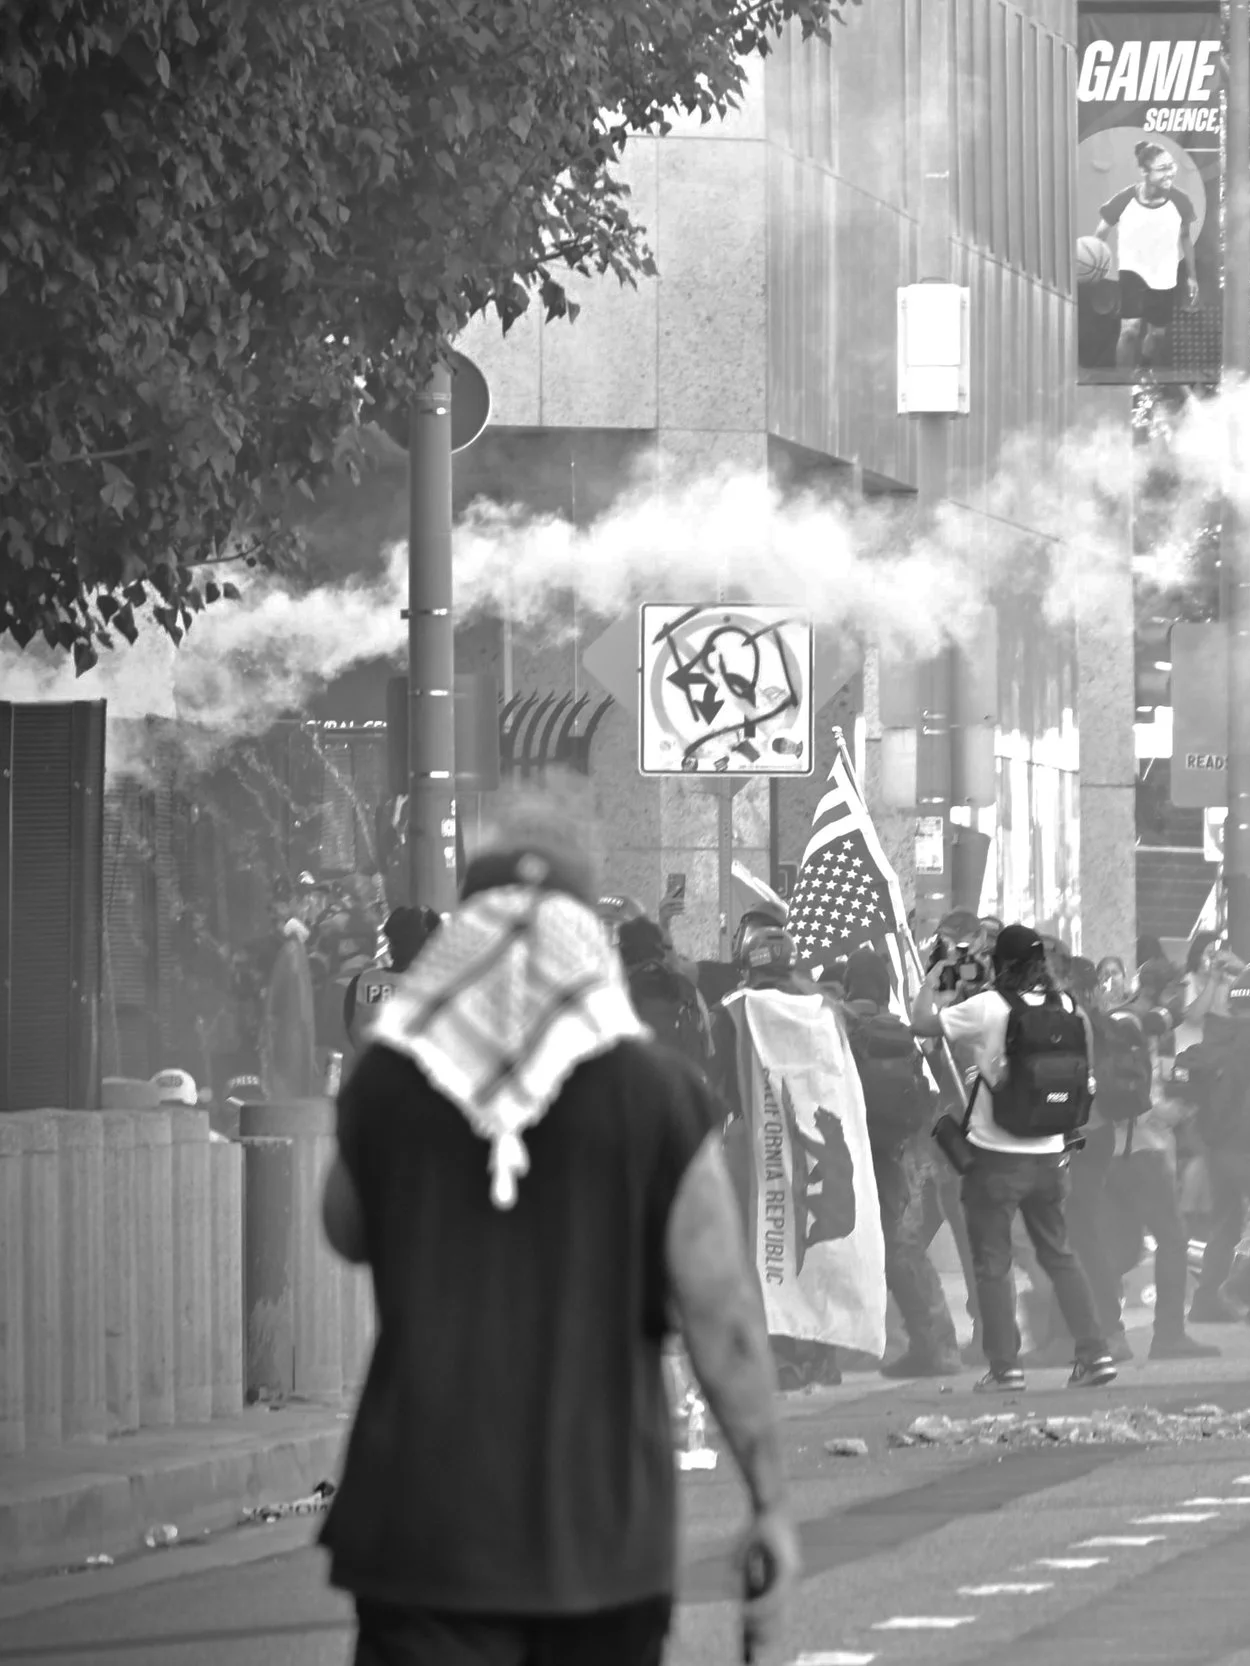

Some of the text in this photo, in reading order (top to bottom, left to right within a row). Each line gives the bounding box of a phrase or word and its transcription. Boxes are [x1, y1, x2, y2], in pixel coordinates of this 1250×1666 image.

[1077, 40, 1221, 102] GAME
[1143, 107, 1220, 132] SCIENCE,
[1186, 754, 1228, 770] READ
[764, 1189, 786, 1287] REPUBLIC
